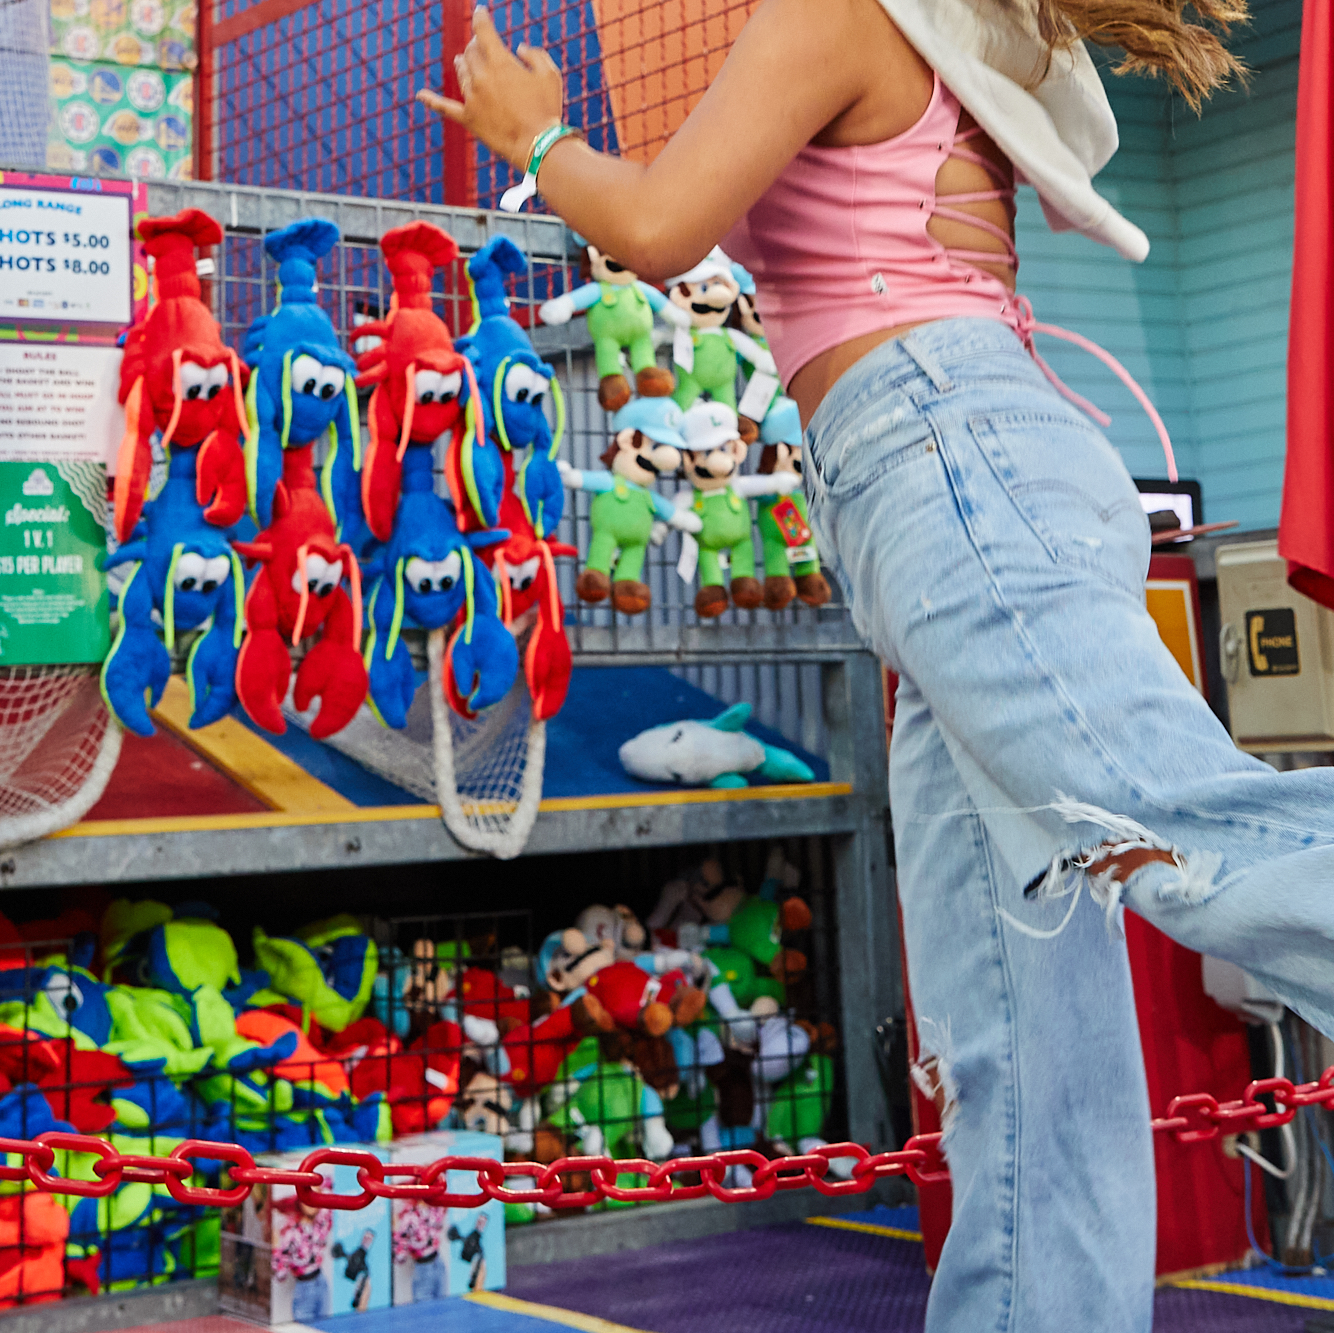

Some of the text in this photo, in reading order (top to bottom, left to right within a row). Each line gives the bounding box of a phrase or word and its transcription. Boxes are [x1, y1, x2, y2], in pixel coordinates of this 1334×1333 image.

[37, 200, 82, 215] RANGE
[63, 233, 109, 248] $5.00
[64, 259, 110, 275] $8.00
[15, 554, 40, 575] PER
[40, 554, 83, 575] PLAYER
[1260, 636, 1293, 648] PHONE
